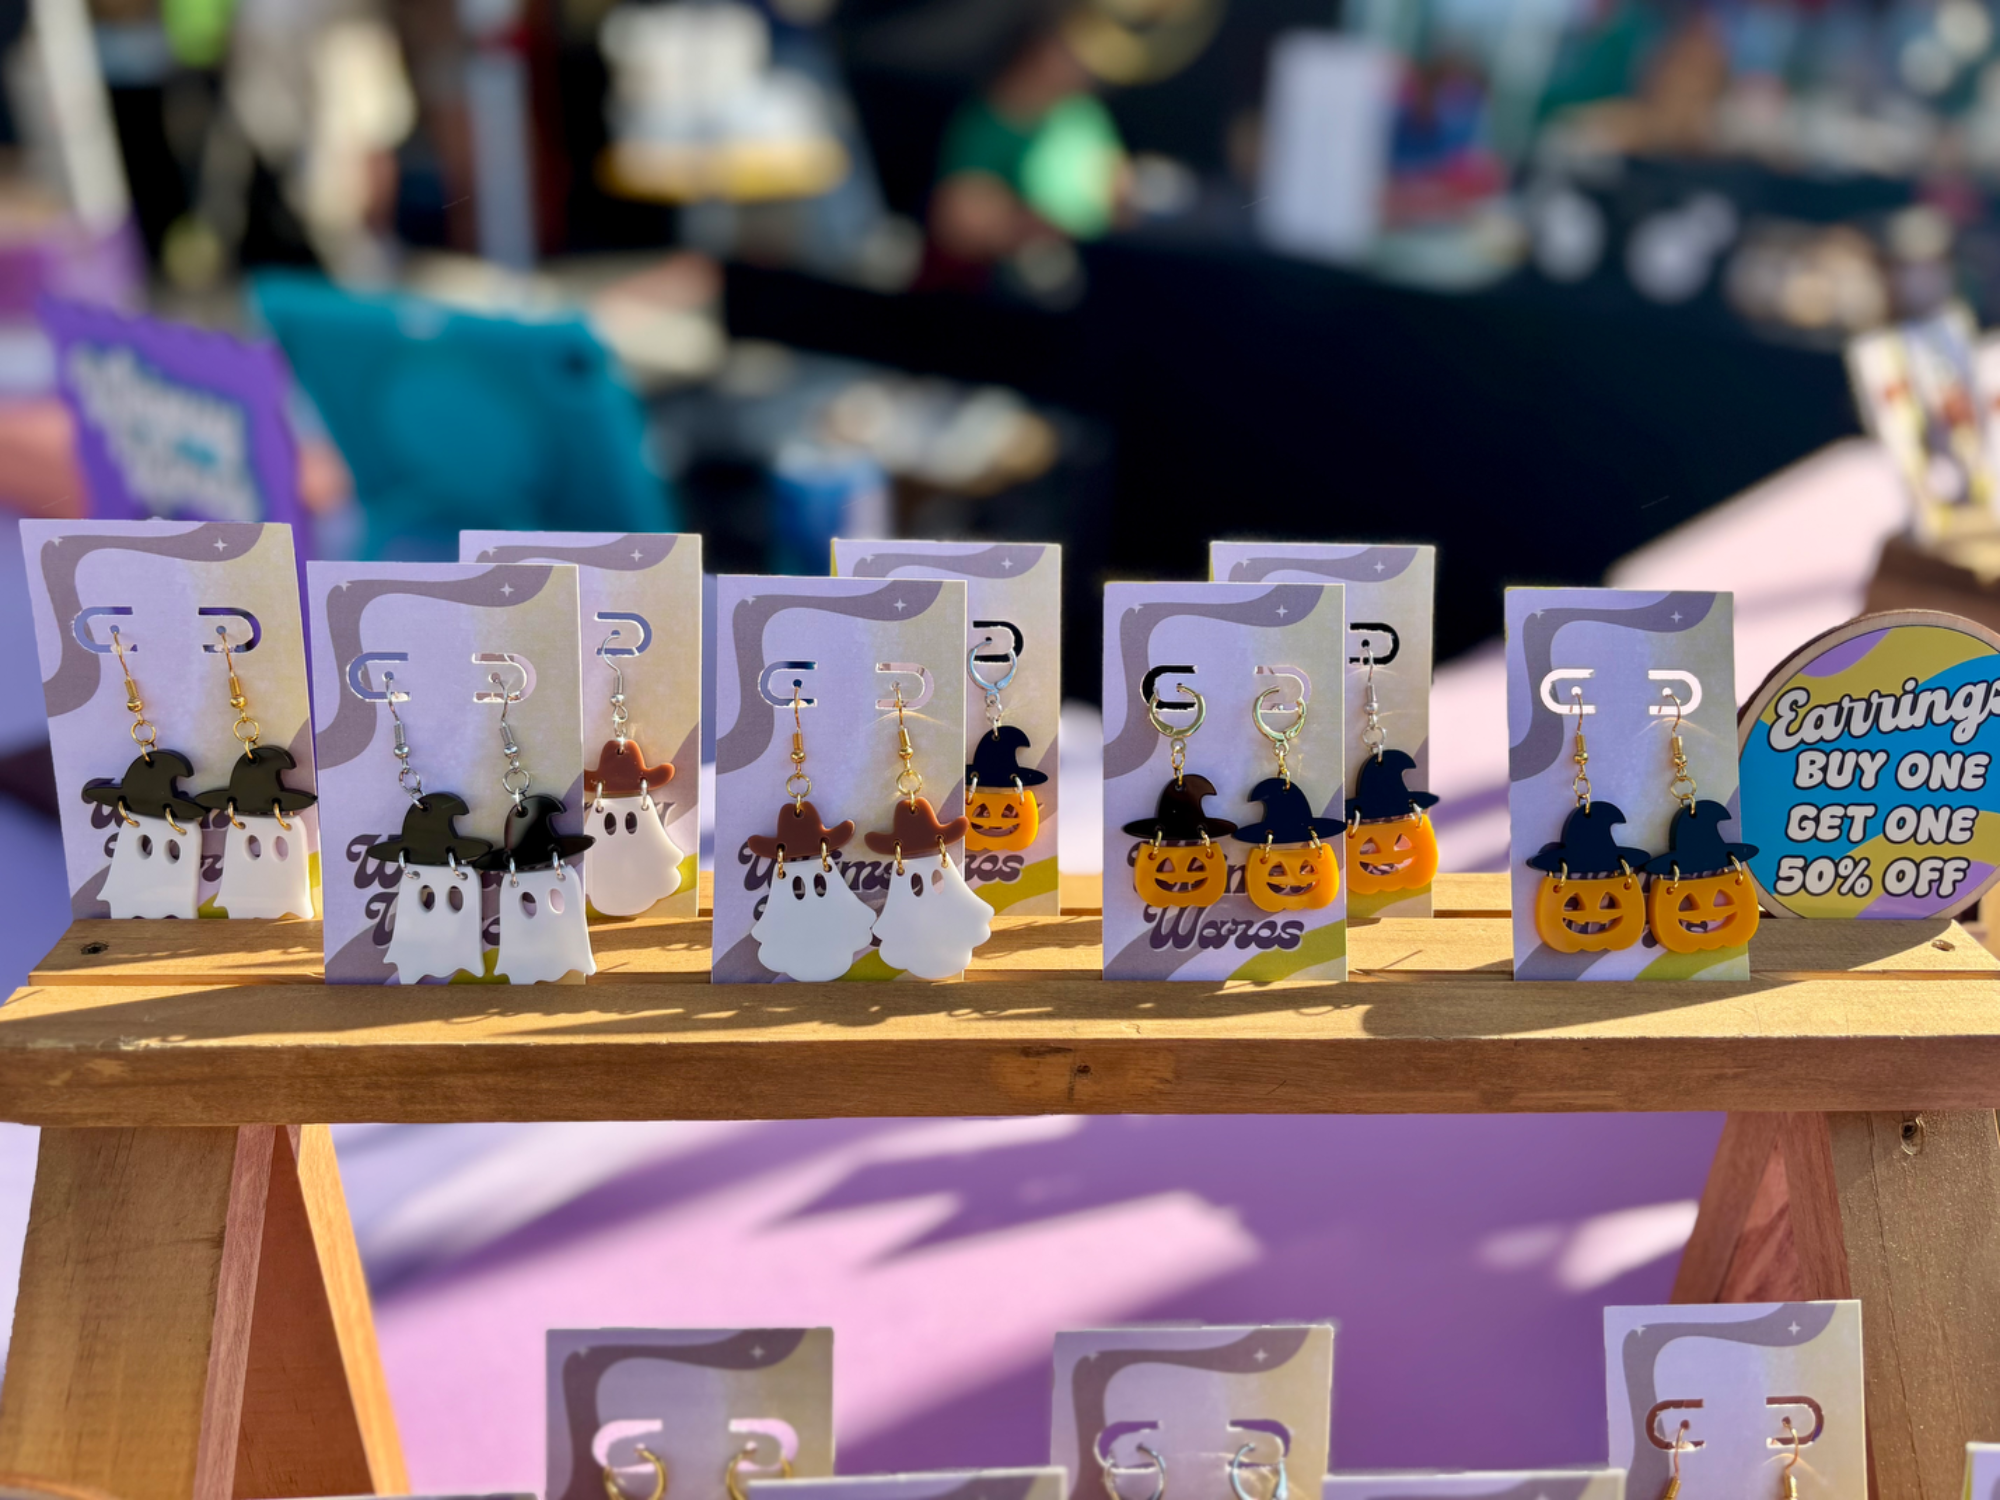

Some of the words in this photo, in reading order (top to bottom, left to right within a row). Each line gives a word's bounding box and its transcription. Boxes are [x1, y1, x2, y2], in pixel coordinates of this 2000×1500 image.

[1793, 749, 1889, 790] BUY
[1895, 750, 1991, 791] ONE
[1786, 803, 1878, 843] GET
[1883, 804, 1979, 845] ONE
[1774, 855, 1872, 897] 50%
[1882, 857, 1971, 898] OFF
